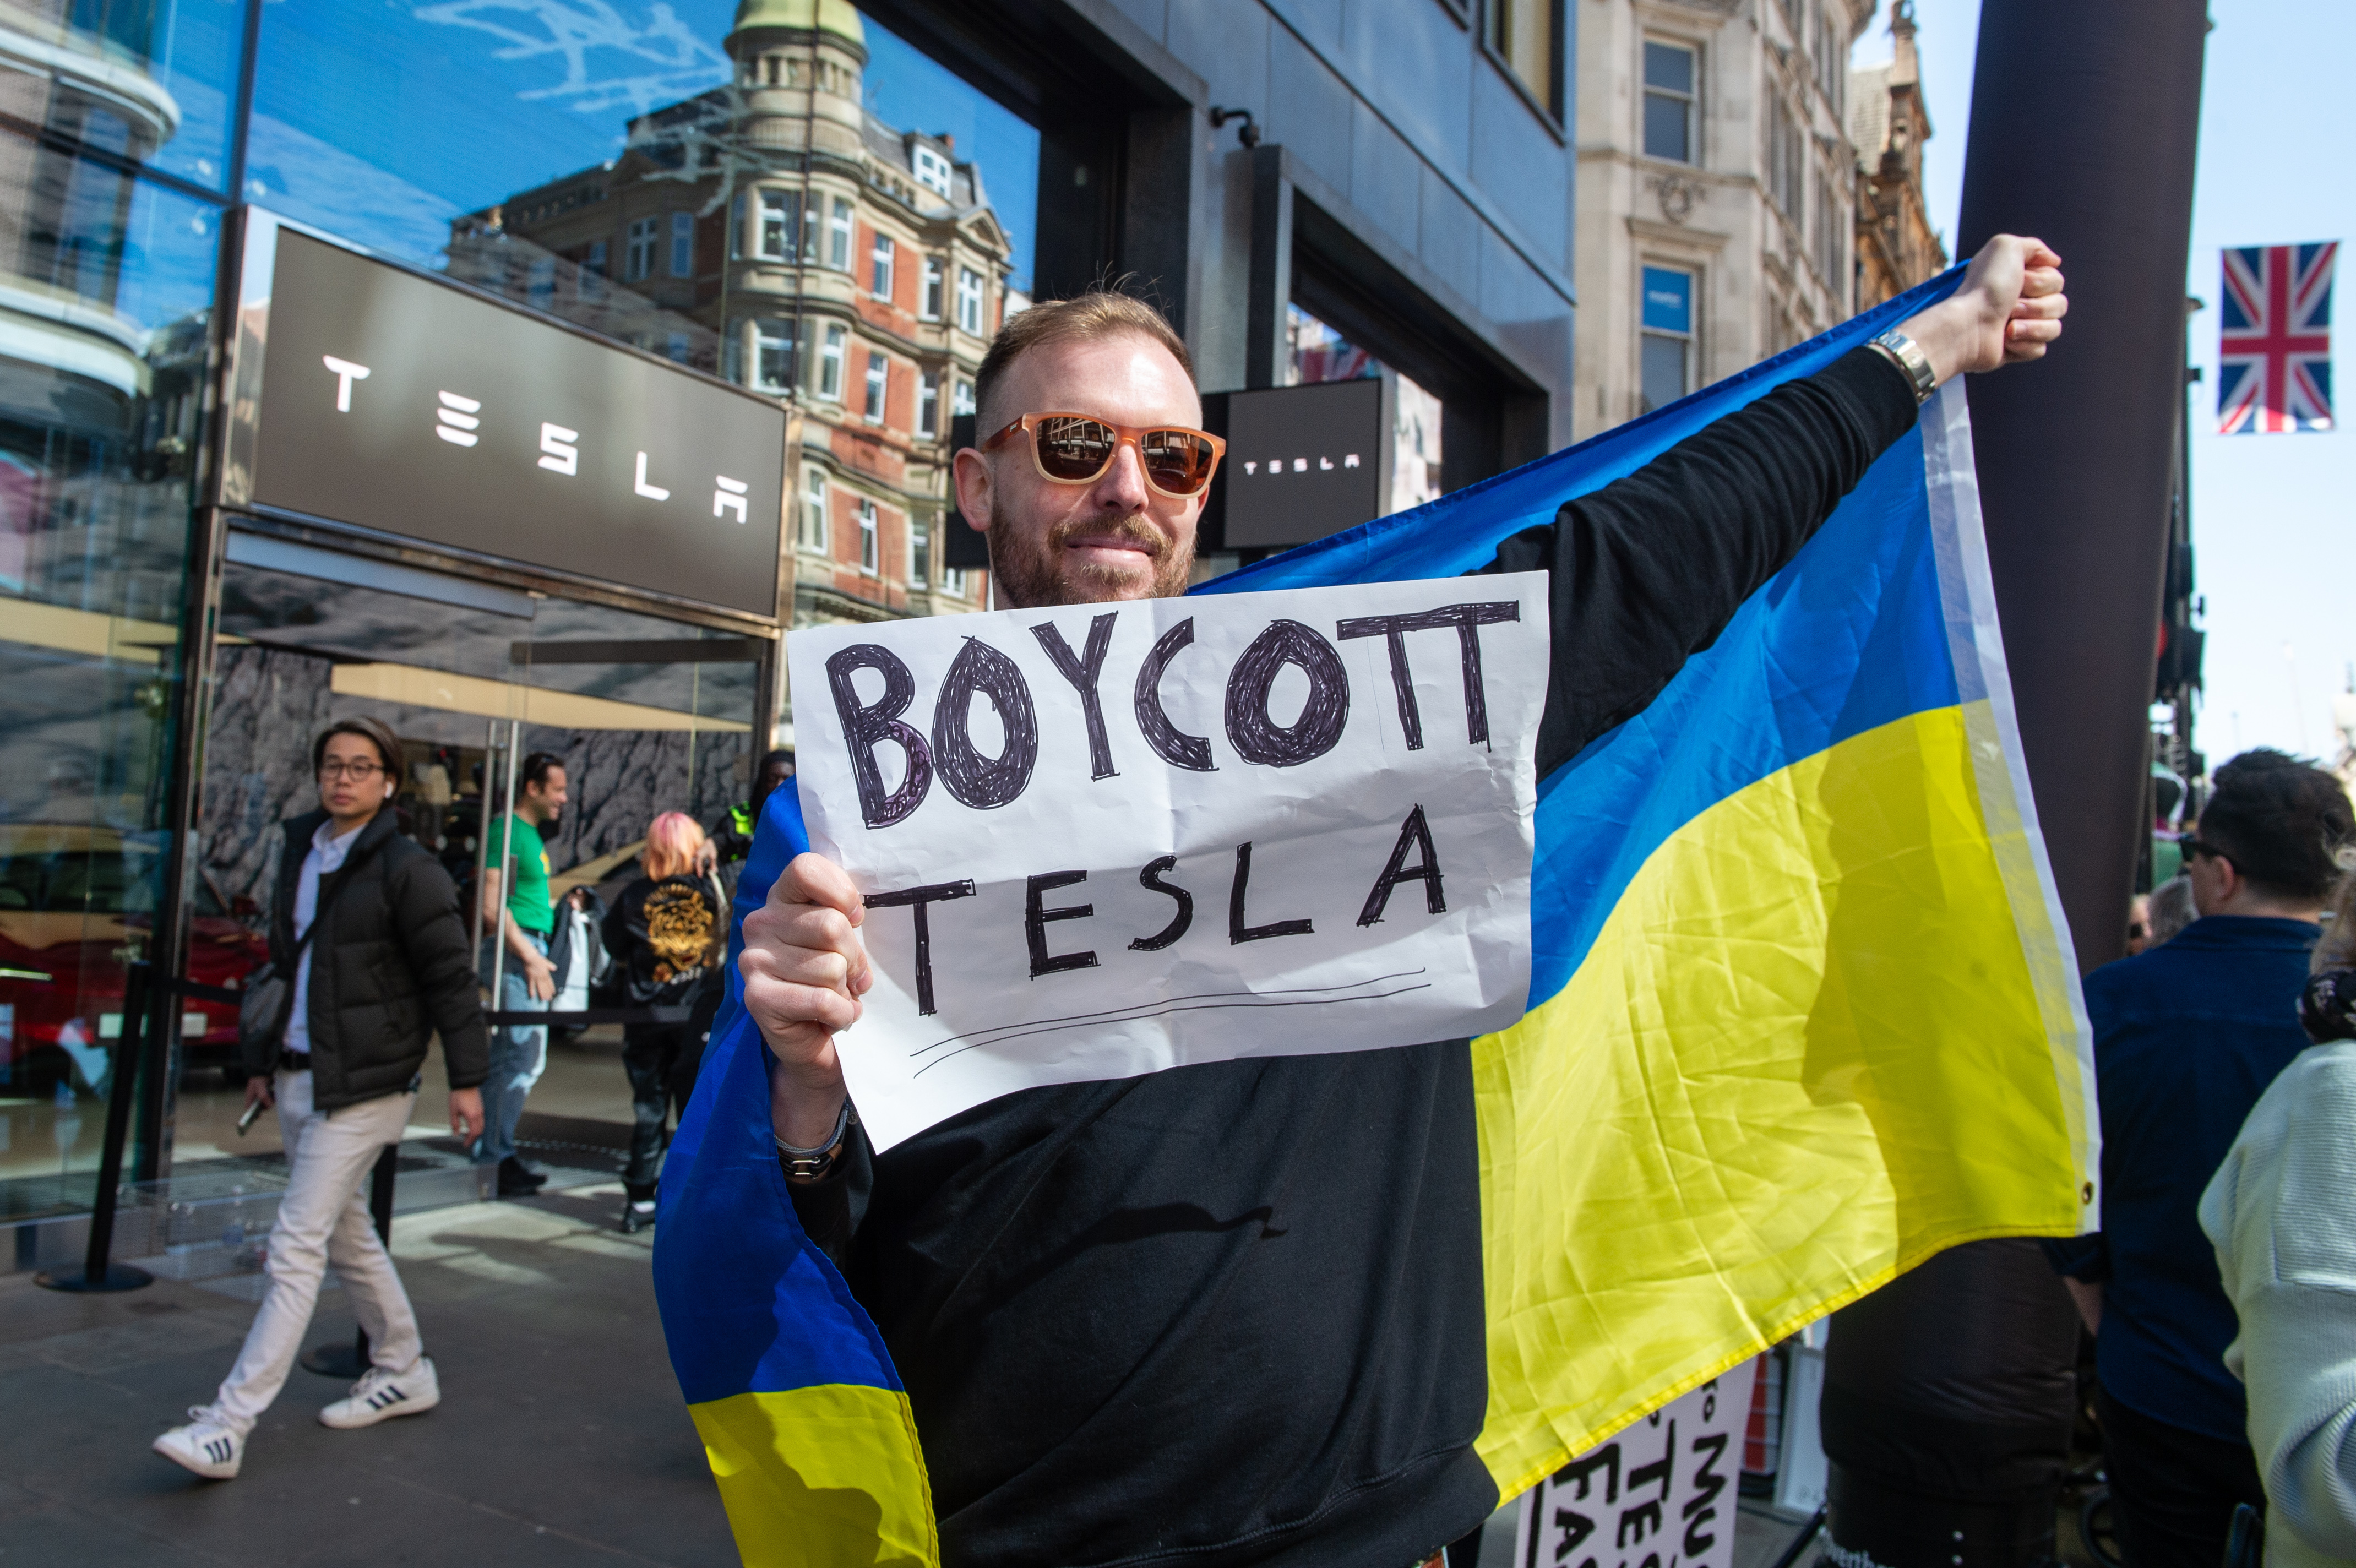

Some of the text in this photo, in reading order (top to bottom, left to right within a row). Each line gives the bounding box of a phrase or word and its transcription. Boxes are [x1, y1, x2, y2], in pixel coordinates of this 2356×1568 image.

[323, 355, 748, 524] TESLA
[1243, 454, 1361, 476] TESLA
[824, 599, 1521, 831] BOYCOTT
[862, 802, 1448, 1017] TESLA
[1552, 1442, 1621, 1568] FA
[1682, 1432, 1729, 1568] MU
